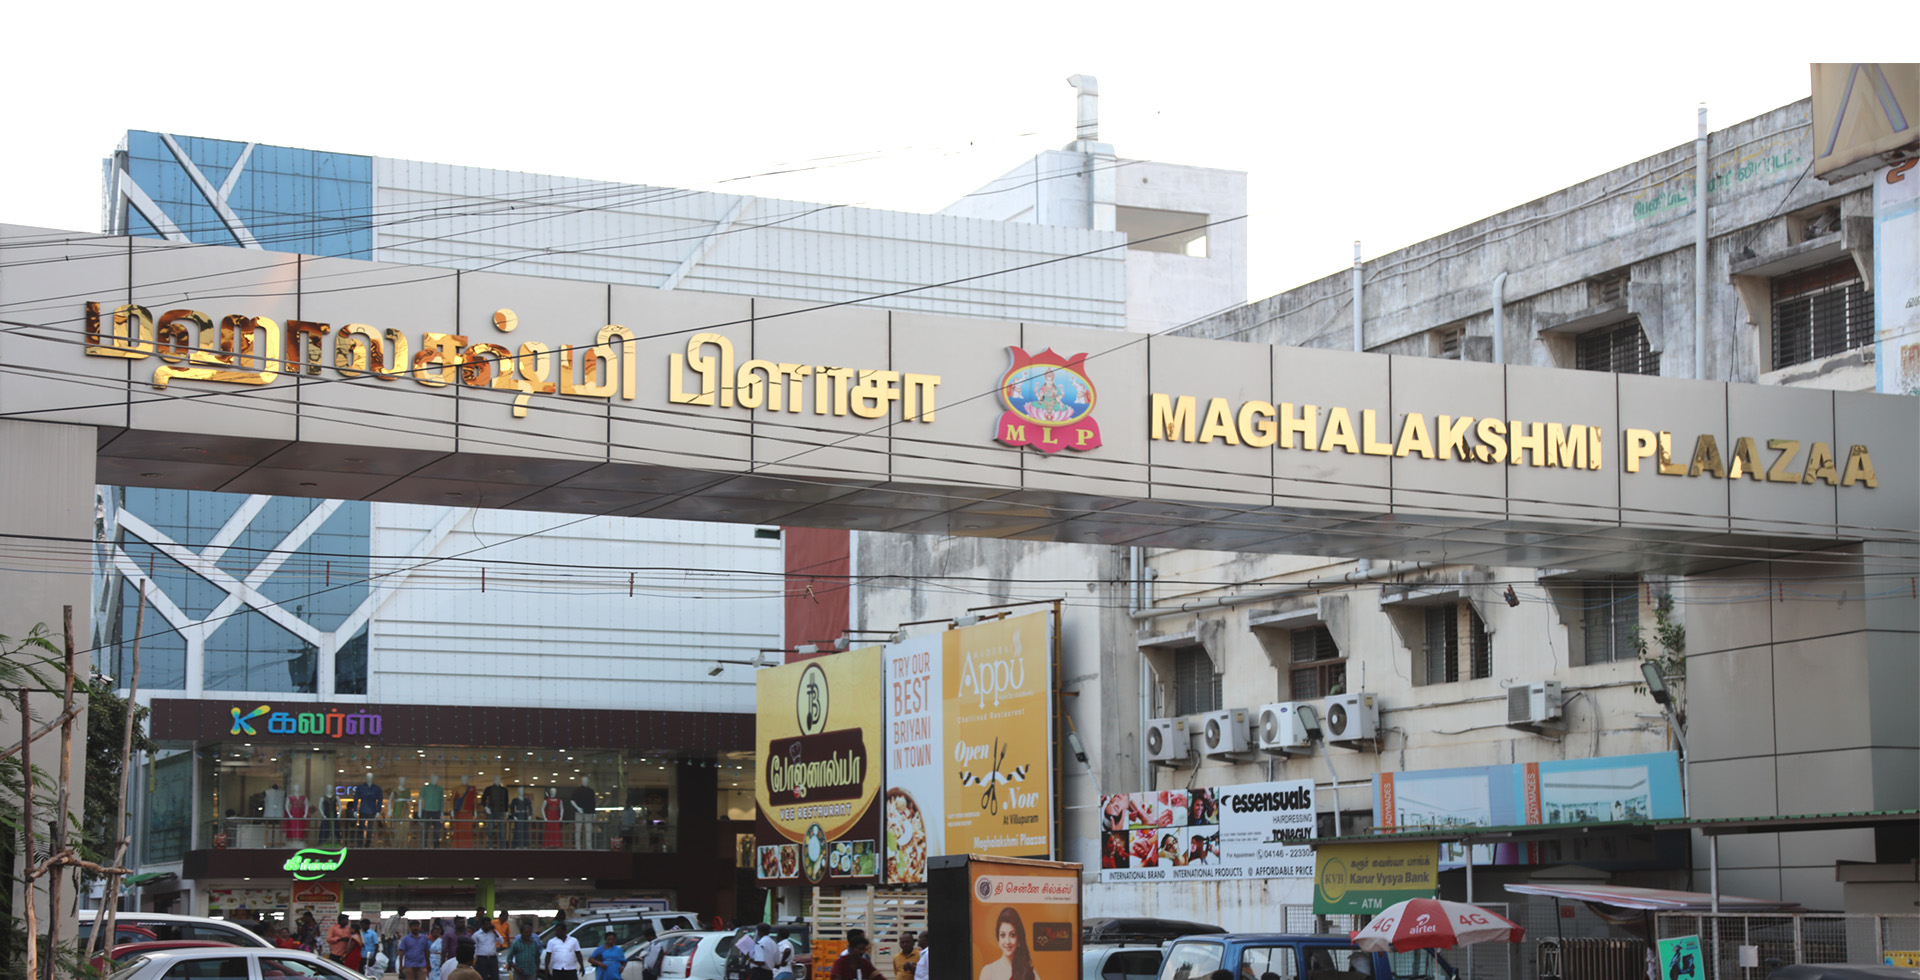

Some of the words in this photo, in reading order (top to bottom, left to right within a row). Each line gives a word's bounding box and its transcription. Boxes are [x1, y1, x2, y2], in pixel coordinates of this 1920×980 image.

[669, 332, 942, 424] பிளாசா
[1150, 392, 1603, 472] MAGHALAKSHMI
[1624, 427, 1879, 490] PLAAZAA
[893, 656, 910, 679] TRY
[912, 652, 930, 675] OUR
[893, 675, 931, 717] BEST
[268, 708, 382, 738] கலர்ஸ்
[893, 716, 931, 745] BRIYANI
[893, 748, 902, 770] IN
[904, 743, 931, 768] TOWN
[955, 740, 989, 767] Open
[1003, 787, 1039, 810] Now
[1232, 785, 1311, 814] essensuals
[1527, 773, 1539, 825] EADYMADES
[780, 808, 795, 821] VEG
[798, 802, 852, 820] RESTAURANT
[1272, 813, 1313, 824] HAIRDRESSING
[1109, 871, 1147, 880] INTERNATIONAL
[1148, 870, 1166, 879] BRAND
[1173, 868, 1214, 879] INTERNATIONAL
[1214, 867, 1243, 877] PRODUCTS
[1255, 866, 1294, 876] AFFORDABLE
[1295, 866, 1313, 876] PRICE
[1325, 873, 1344, 884] KVB
[1350, 873, 1374, 884] Karur
[1376, 872, 1403, 887] Vysya
[1405, 872, 1430, 883] Bank
[994, 882, 1004, 896] தி
[1006, 882, 1040, 893] சென்னை
[1361, 898, 1382, 909] ATM
[1372, 917, 1394, 933] 4G
[1409, 924, 1437, 935] airtel
[1459, 913, 1490, 927] 4G
